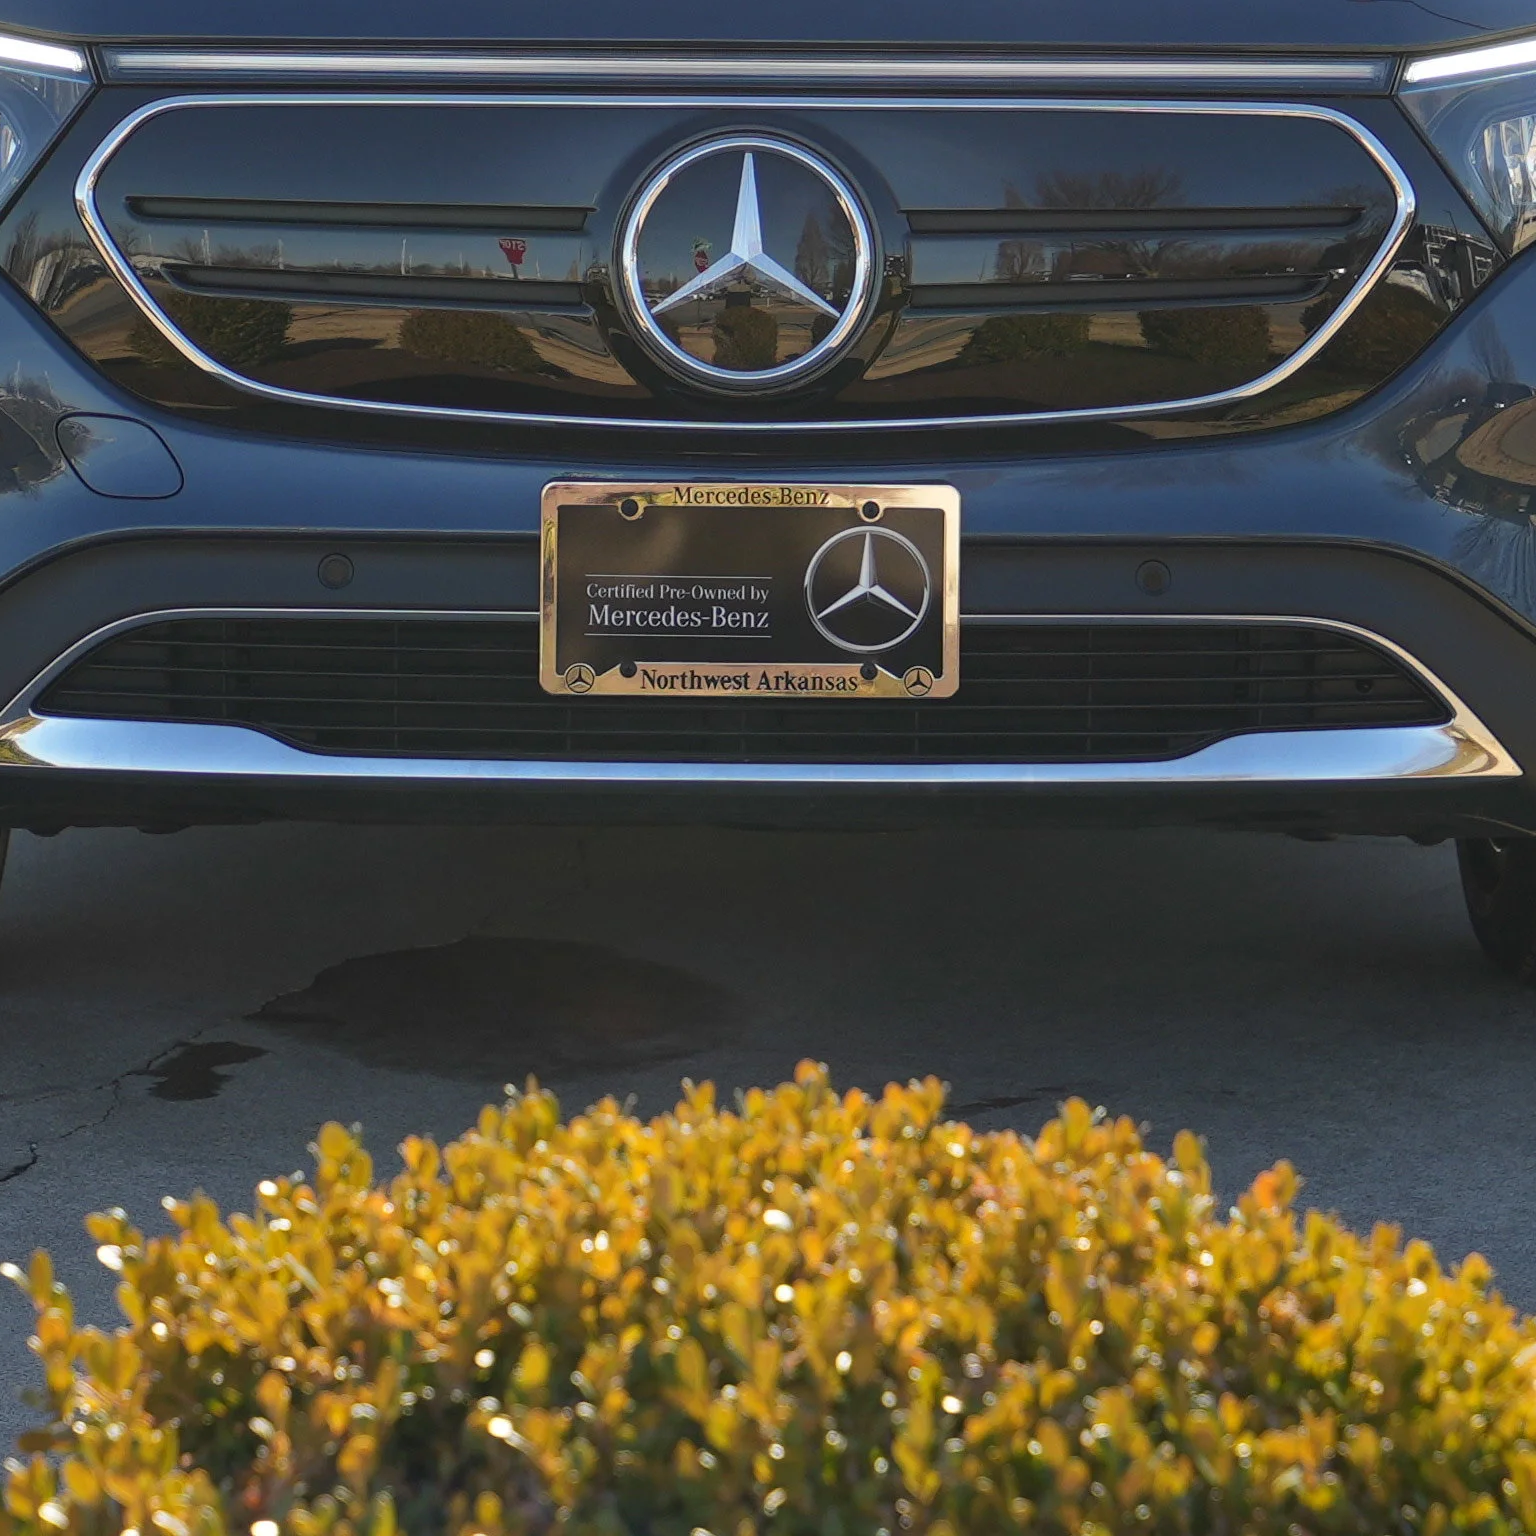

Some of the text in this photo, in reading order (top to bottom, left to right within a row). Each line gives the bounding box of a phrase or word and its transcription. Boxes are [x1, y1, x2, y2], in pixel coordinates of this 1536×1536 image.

[673, 486, 830, 506] Mercedes-Benz
[586, 583, 769, 603] Certified Pre-Owned by
[588, 604, 769, 628] Mercedes-Benz
[640, 669, 859, 692] Northwest Arkansas
